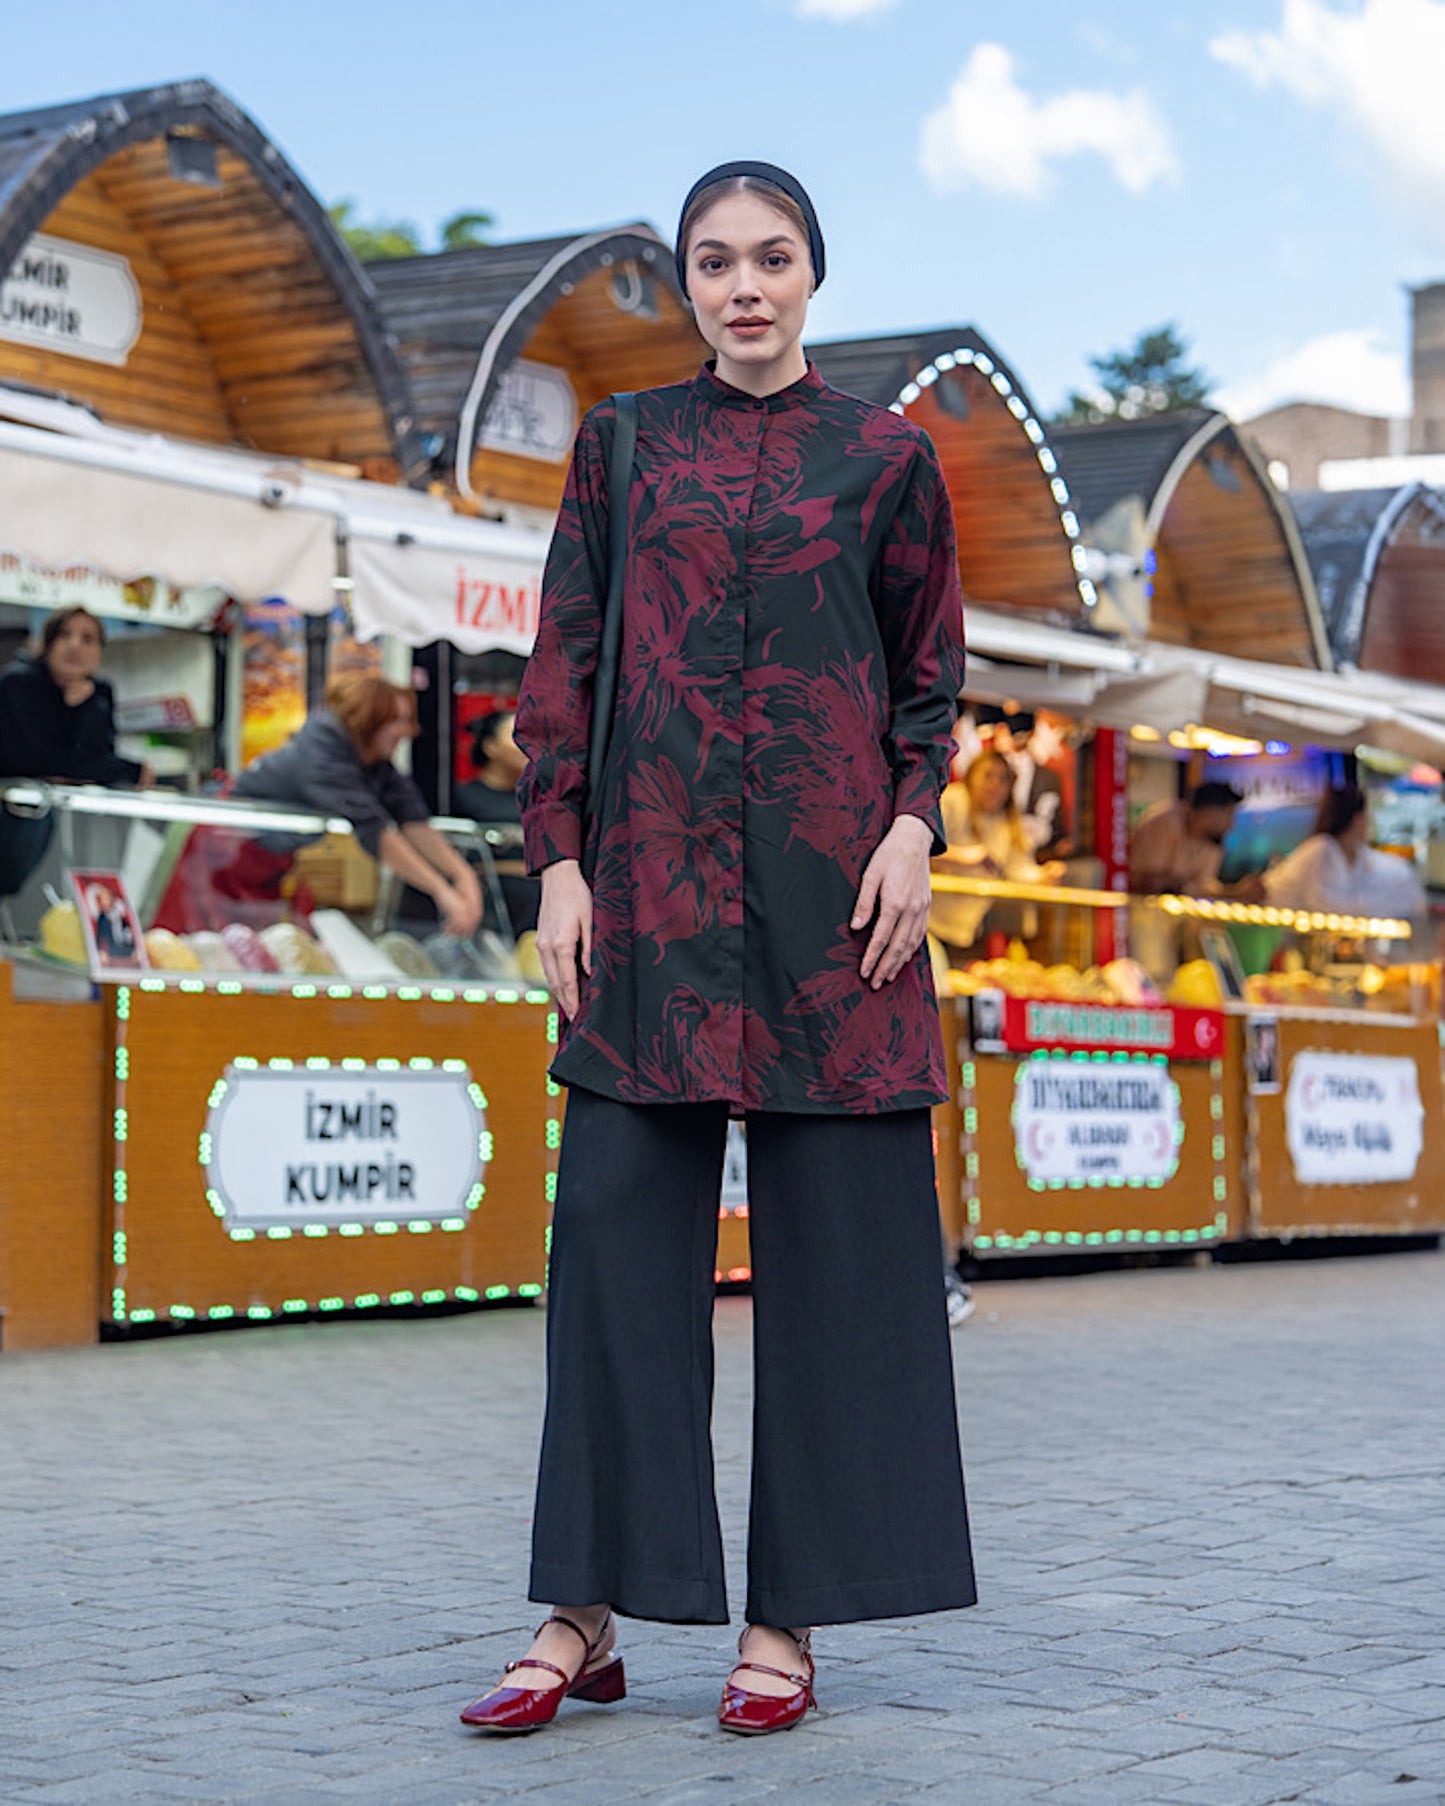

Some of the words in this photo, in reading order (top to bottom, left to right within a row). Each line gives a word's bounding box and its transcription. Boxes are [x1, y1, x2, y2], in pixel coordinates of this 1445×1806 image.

[8, 251, 71, 292] MİR
[1, 297, 81, 337] UMPİR
[456, 564, 540, 634] İZMİ
[305, 1088, 398, 1140] İZMİR
[286, 1151, 415, 1202] KUMPİR
